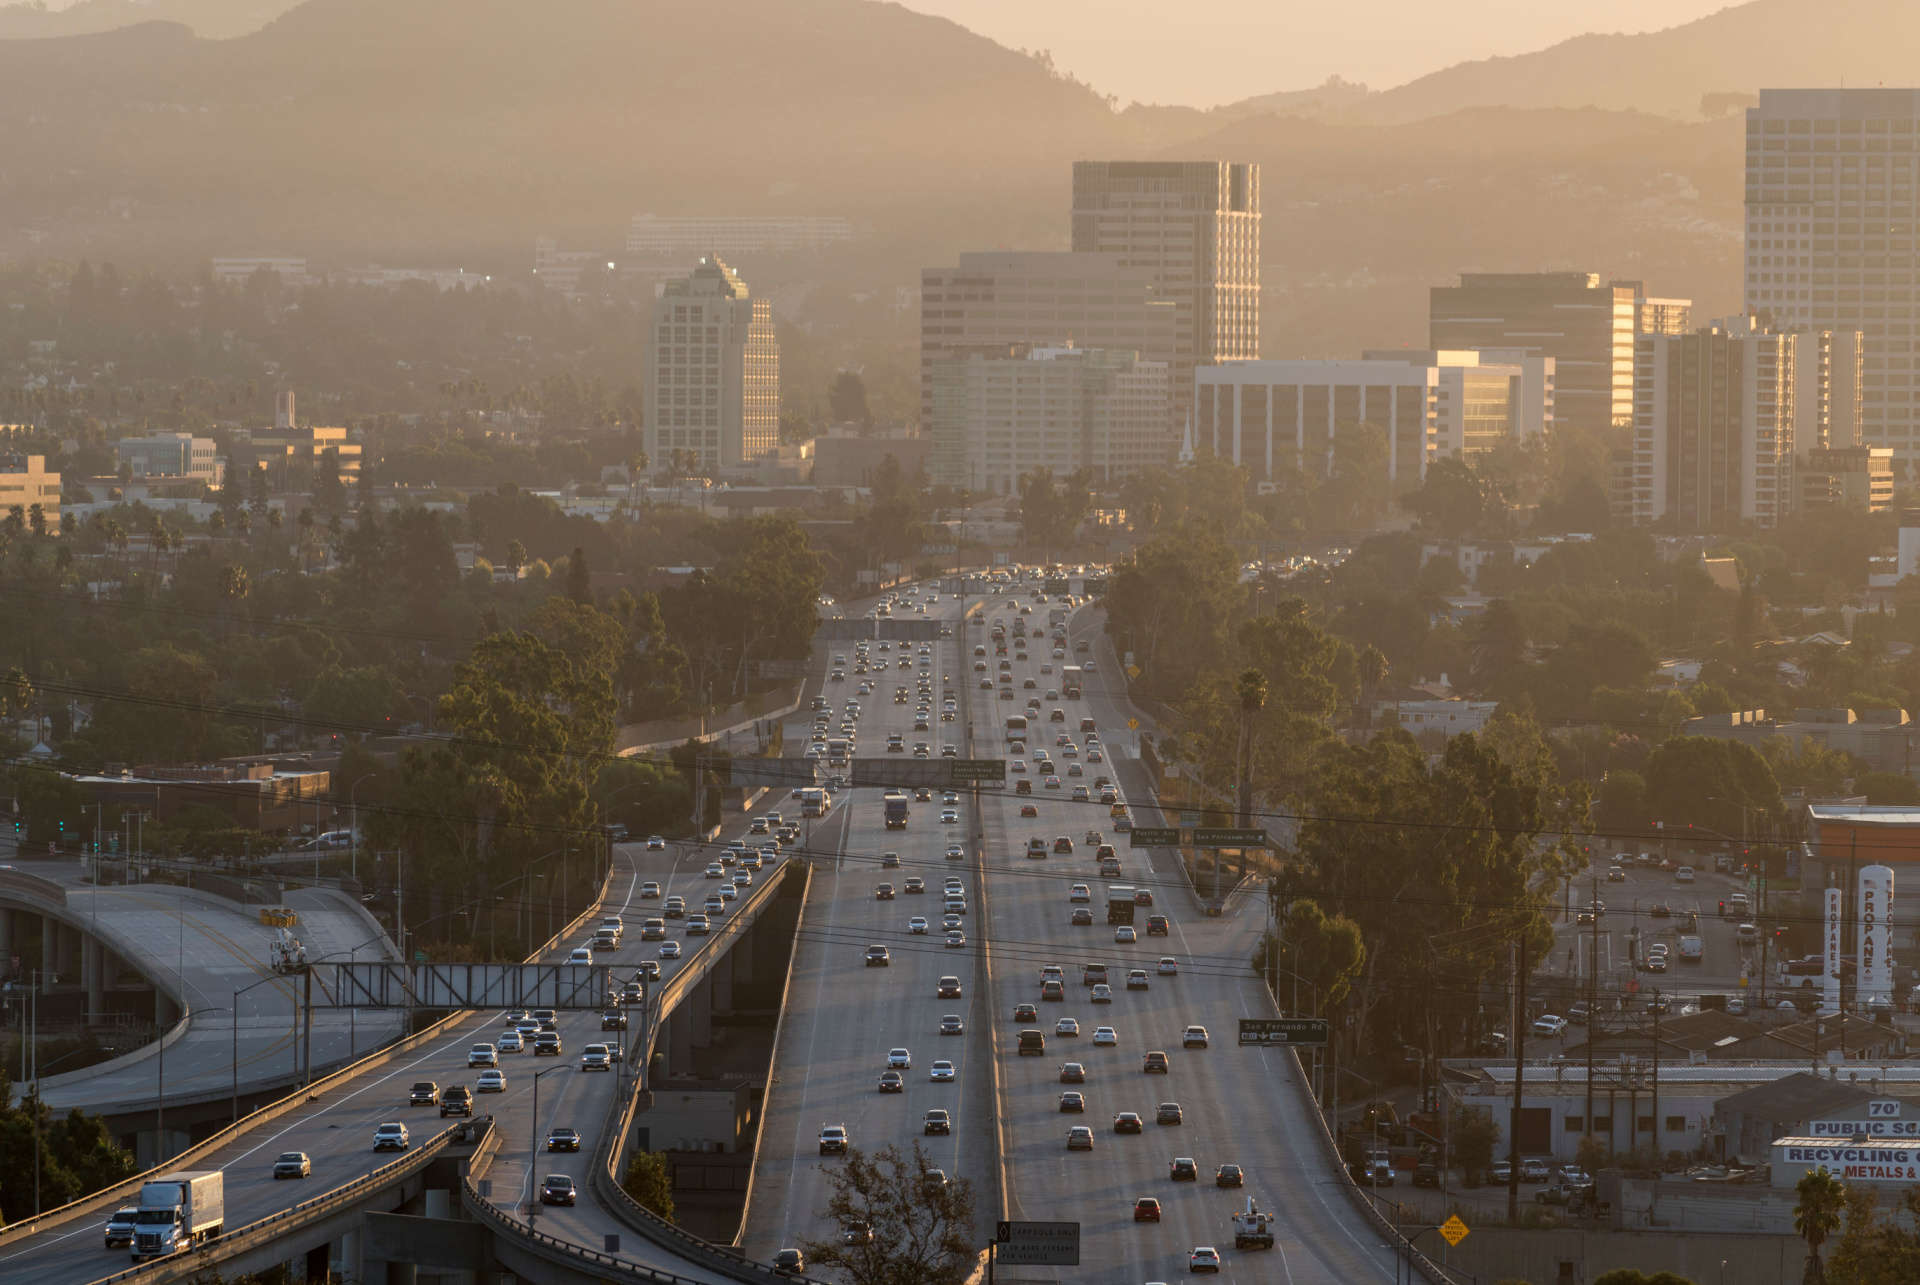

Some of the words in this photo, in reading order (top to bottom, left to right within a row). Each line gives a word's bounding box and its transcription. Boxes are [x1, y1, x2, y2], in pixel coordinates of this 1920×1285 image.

[1863, 891, 1874, 968] PROPANE
[1265, 1023, 1306, 1031] Fernando
[1311, 1023, 1323, 1031] Rd
[1871, 1103, 1898, 1115] 70'
[1815, 1123, 1884, 1134] PUBLIC
[1892, 1123, 1920, 1134] SC
[1789, 1149, 1908, 1162] RECYCLING
[1844, 1166, 1903, 1178] METALS
[1907, 1167, 1916, 1178] &
